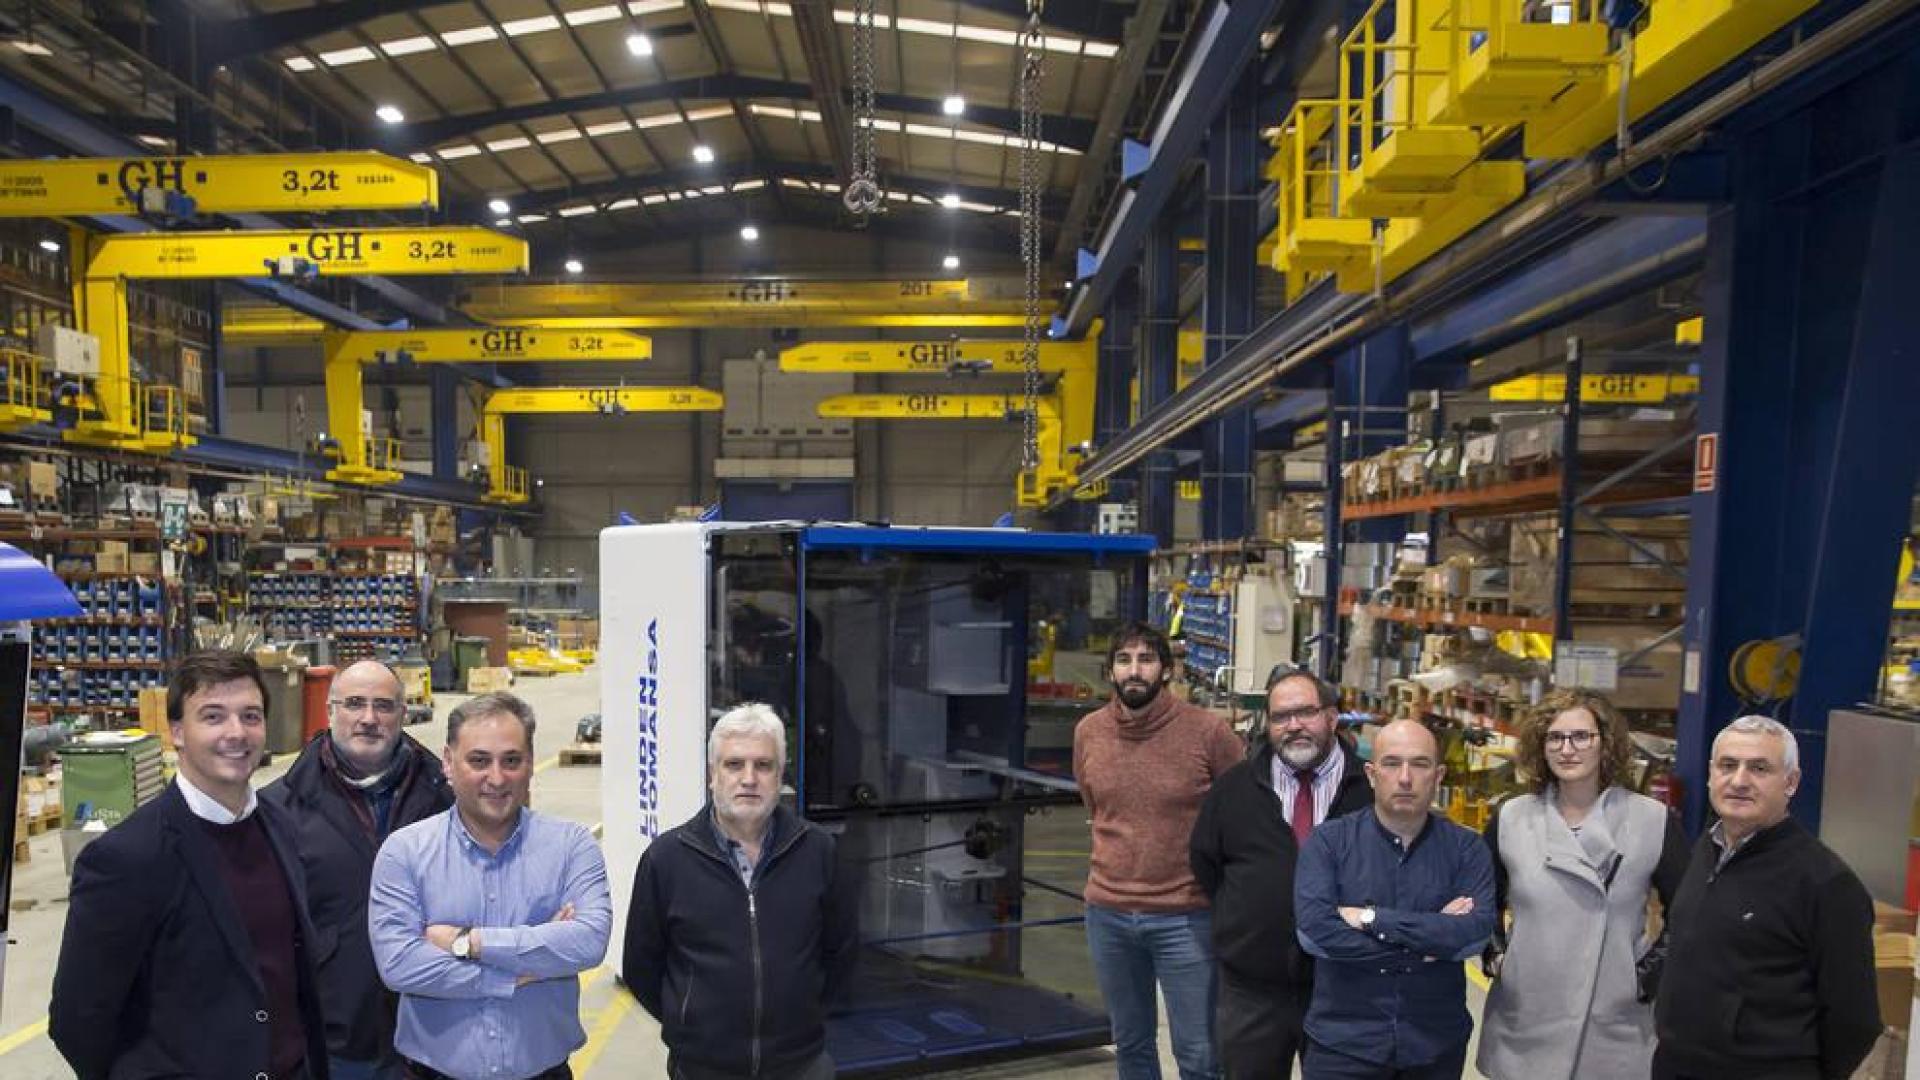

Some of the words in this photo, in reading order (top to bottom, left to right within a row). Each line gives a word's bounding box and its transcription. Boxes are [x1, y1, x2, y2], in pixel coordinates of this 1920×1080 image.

[118, 160, 187, 196] GH
[282, 169, 341, 197] 3,2t
[307, 232, 364, 261] GH
[408, 240, 458, 262] 3,2t
[741, 282, 783, 301] GH
[482, 330, 523, 351] GH
[570, 337, 604, 353] 3,2t
[910, 344, 949, 362] GH
[1601, 376, 1634, 394] GH
[589, 390, 618, 404] GH
[908, 394, 939, 411] GH
[648, 618, 658, 840] COMANSA
[639, 676, 649, 836] LINDEN
